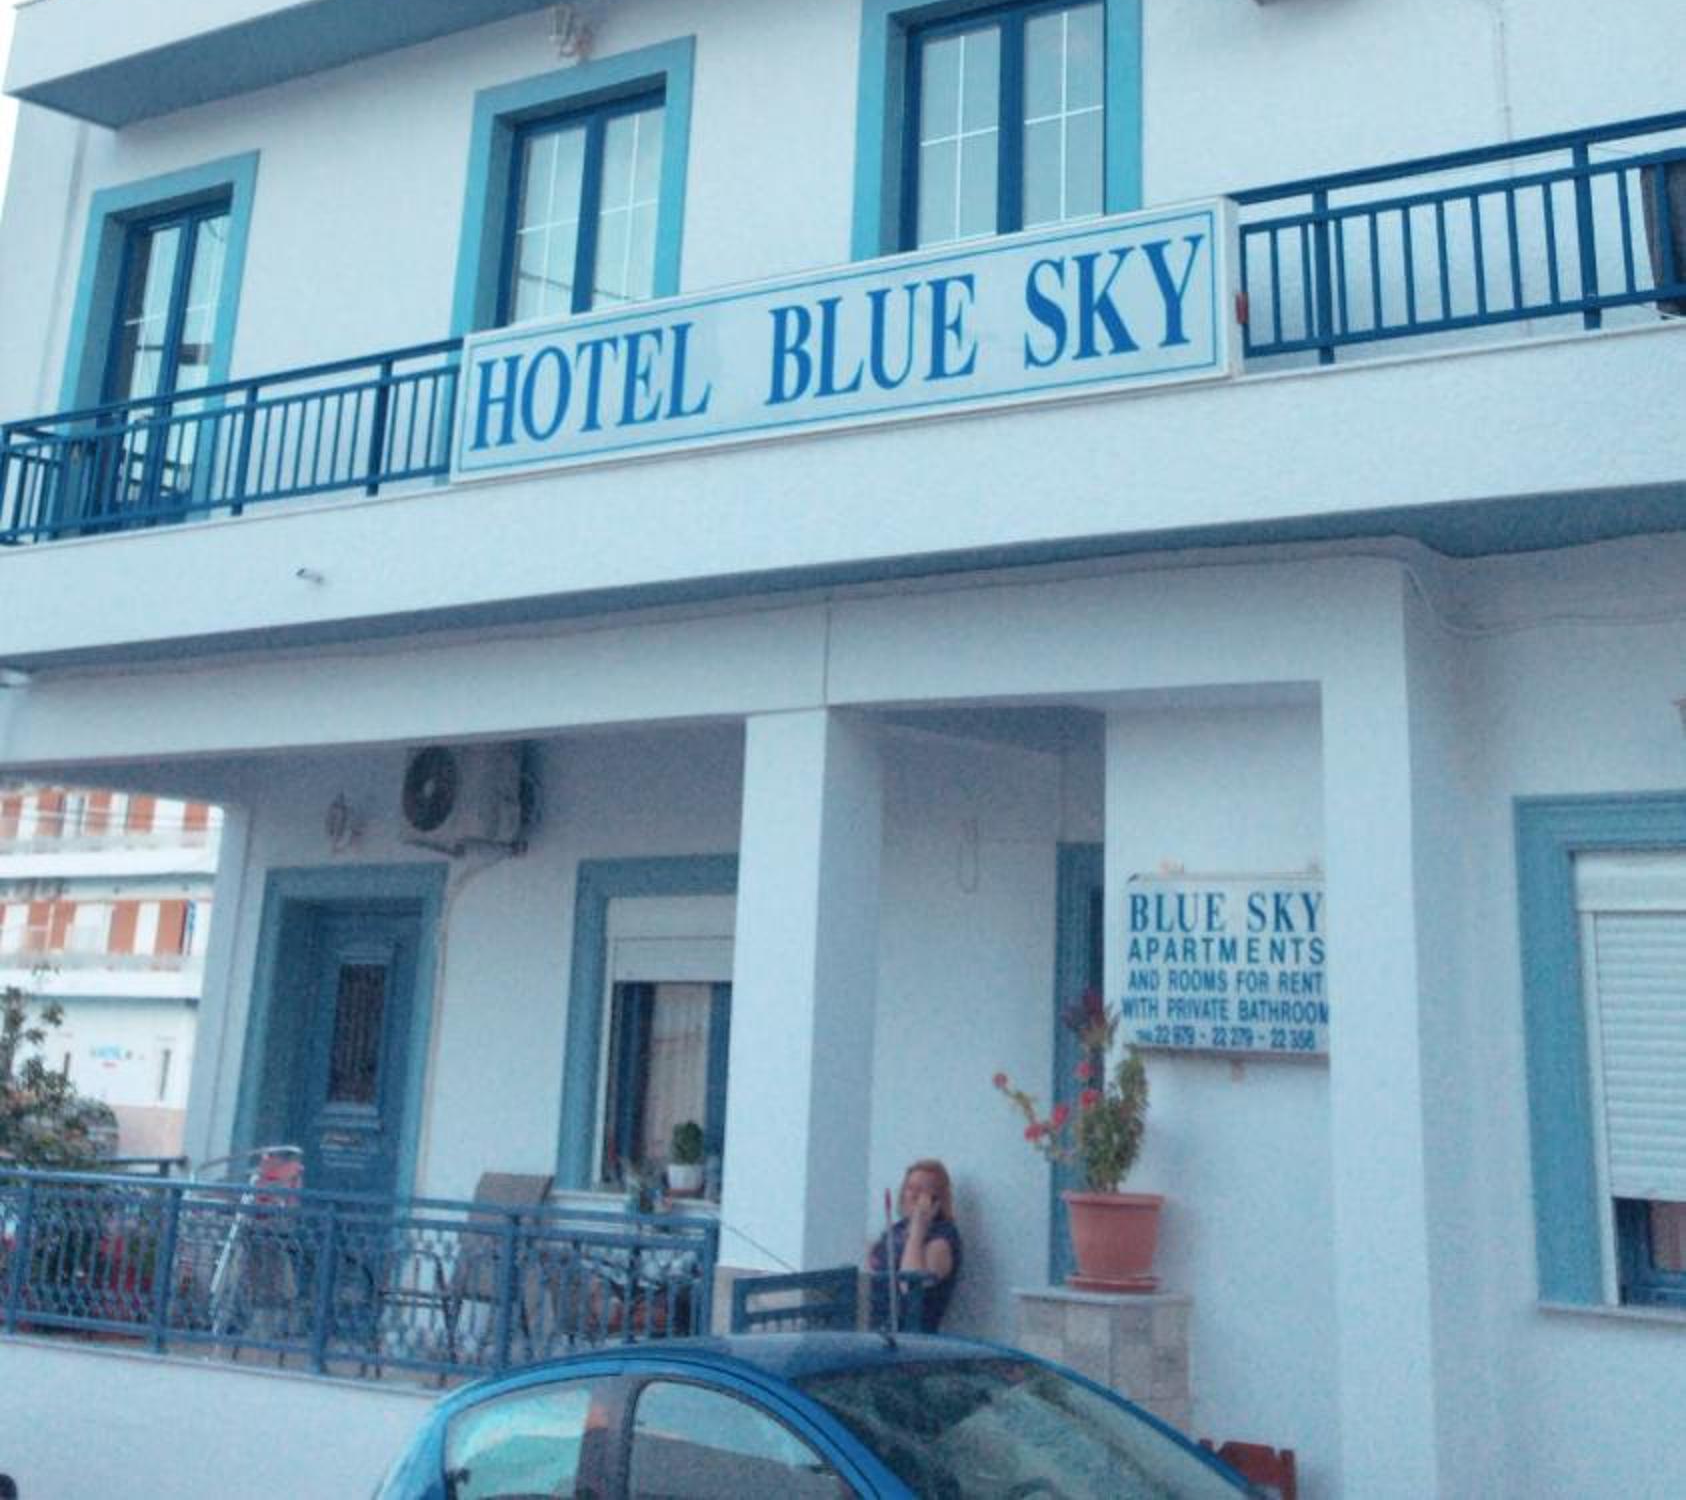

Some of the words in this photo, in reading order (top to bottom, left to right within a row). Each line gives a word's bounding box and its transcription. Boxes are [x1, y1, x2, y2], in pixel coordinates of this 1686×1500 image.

[470, 321, 711, 452] HOTEL
[765, 273, 978, 406] BLUE
[1023, 233, 1206, 370] SKY
[1129, 893, 1226, 932] BLUE
[1246, 892, 1323, 932] SKY
[1127, 937, 1325, 965] APARTMENTS
[1128, 969, 1159, 991] AND
[1169, 970, 1228, 992] ROOMS
[1236, 971, 1269, 993] FOR
[1279, 971, 1323, 995] RENT
[1121, 997, 1158, 1018] WITH
[1167, 998, 1229, 1021] PRIVATE
